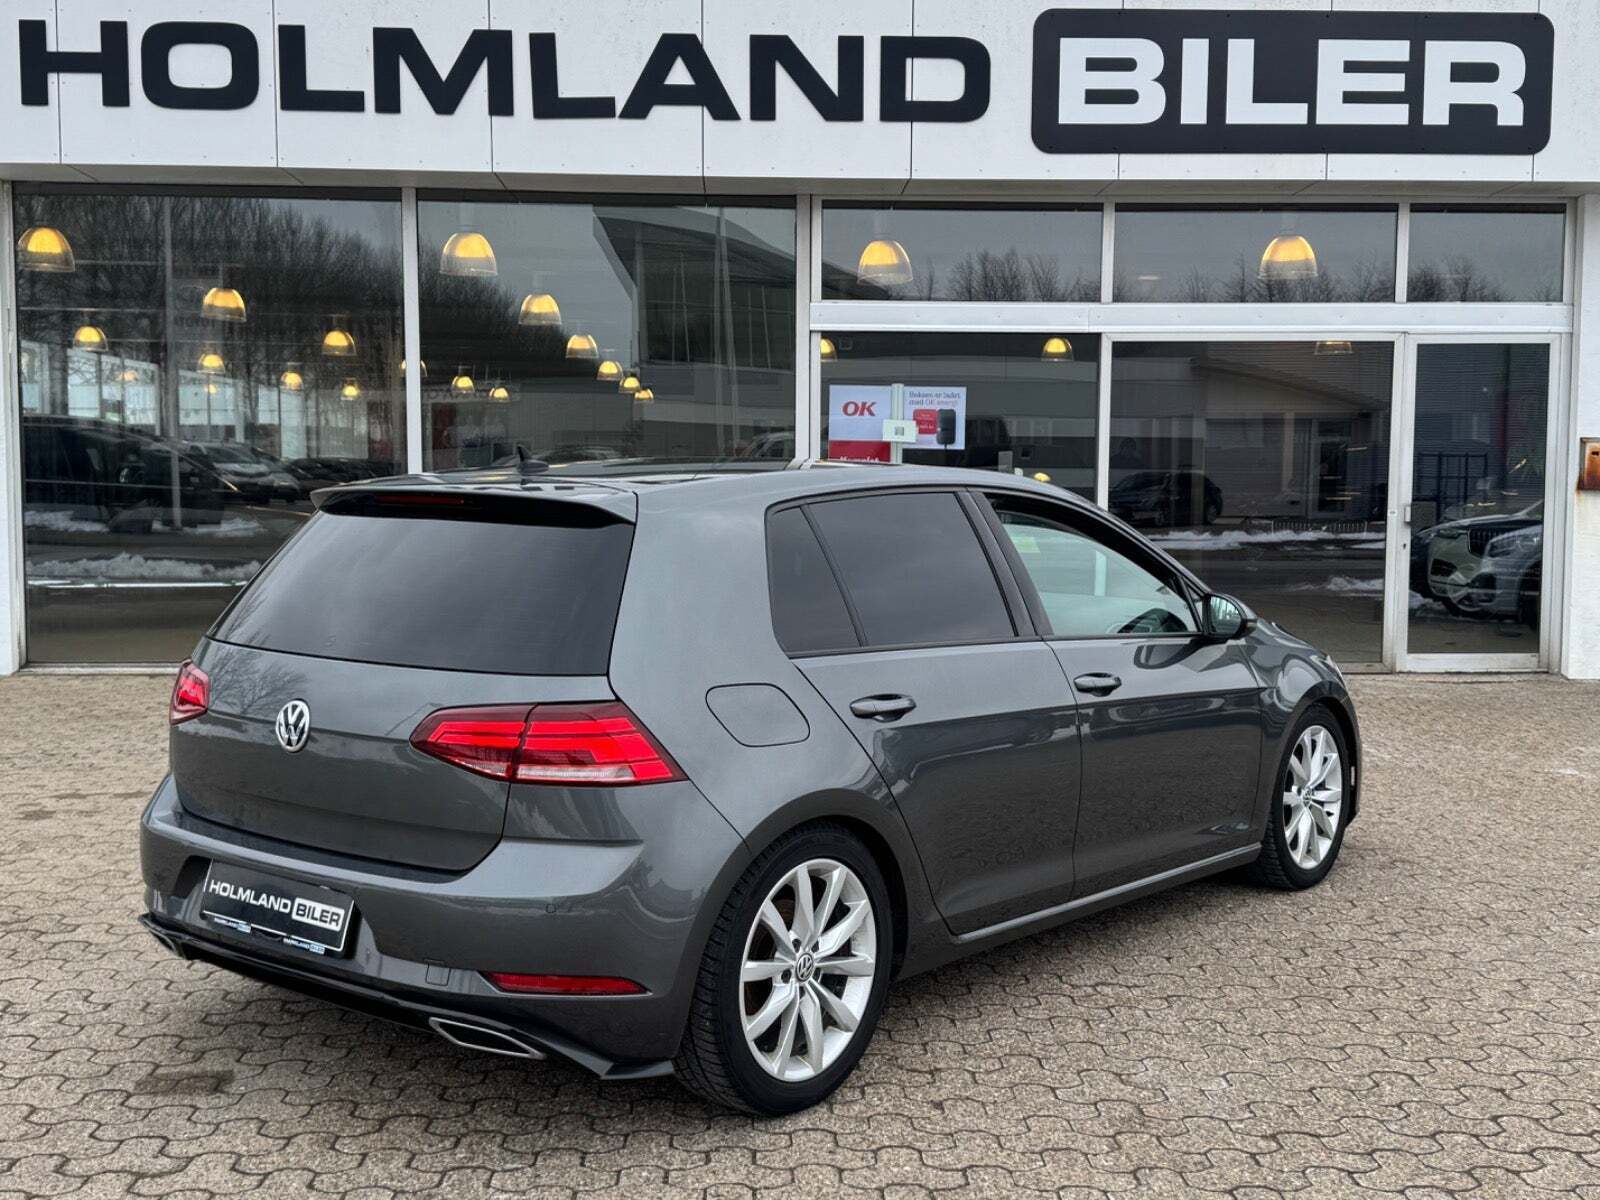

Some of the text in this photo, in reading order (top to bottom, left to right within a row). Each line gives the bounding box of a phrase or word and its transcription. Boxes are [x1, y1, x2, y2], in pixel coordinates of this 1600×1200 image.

[19, 20, 1526, 126] HOLMLAND BILER
[842, 401, 877, 417] OK
[209, 879, 342, 928] HOLMLAND BILER
